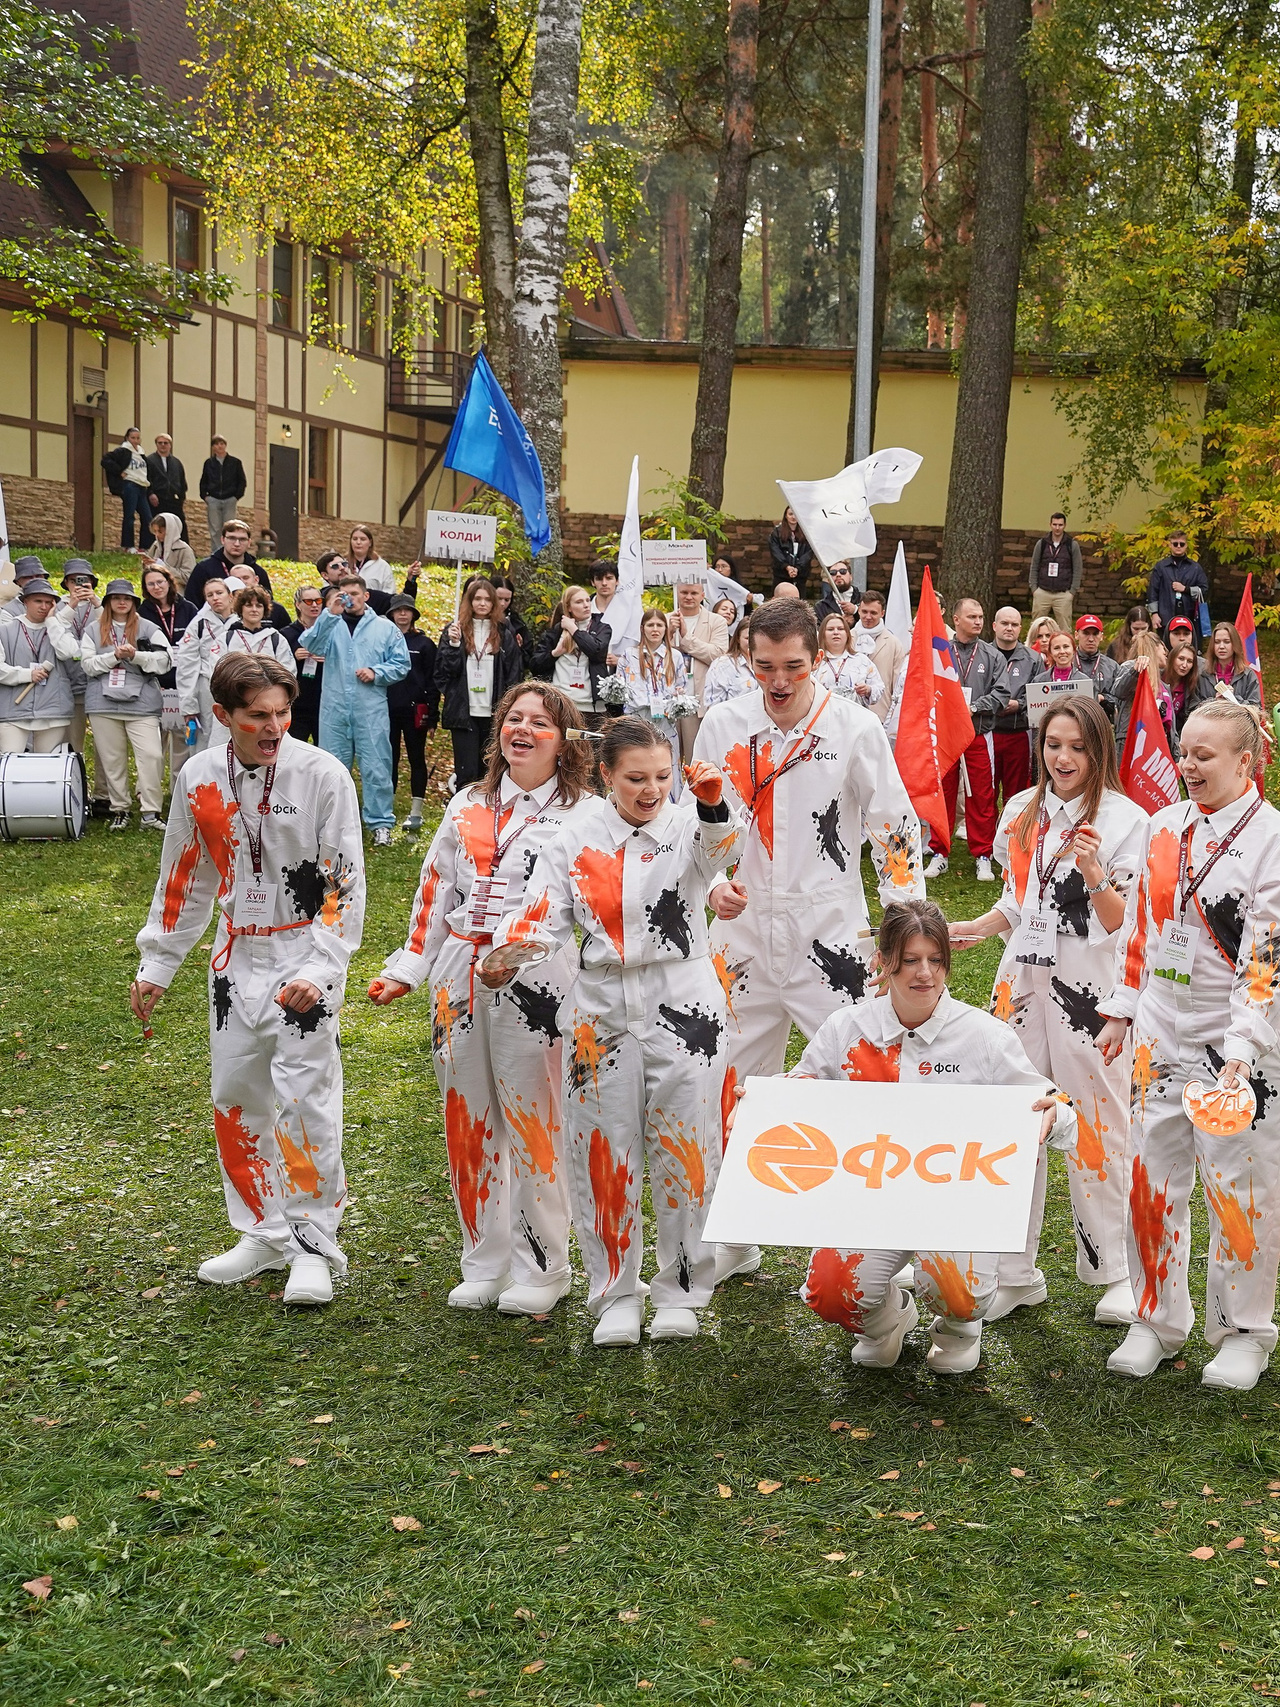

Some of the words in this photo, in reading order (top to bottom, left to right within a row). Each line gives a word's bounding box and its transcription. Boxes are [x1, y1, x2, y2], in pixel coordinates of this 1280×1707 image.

[440, 530, 482, 542] КОЛДИ
[814, 750, 838, 761] ФСК
[272, 804, 298, 815] ФСК
[538, 815, 563, 826] ФСК
[1189, 864, 1210, 890] ФУНДАМЕНТ
[1207, 847, 1223, 865] ГОРОДА
[934, 1062, 960, 1074] ФСК
[842, 1134, 1018, 1189] ФСК
